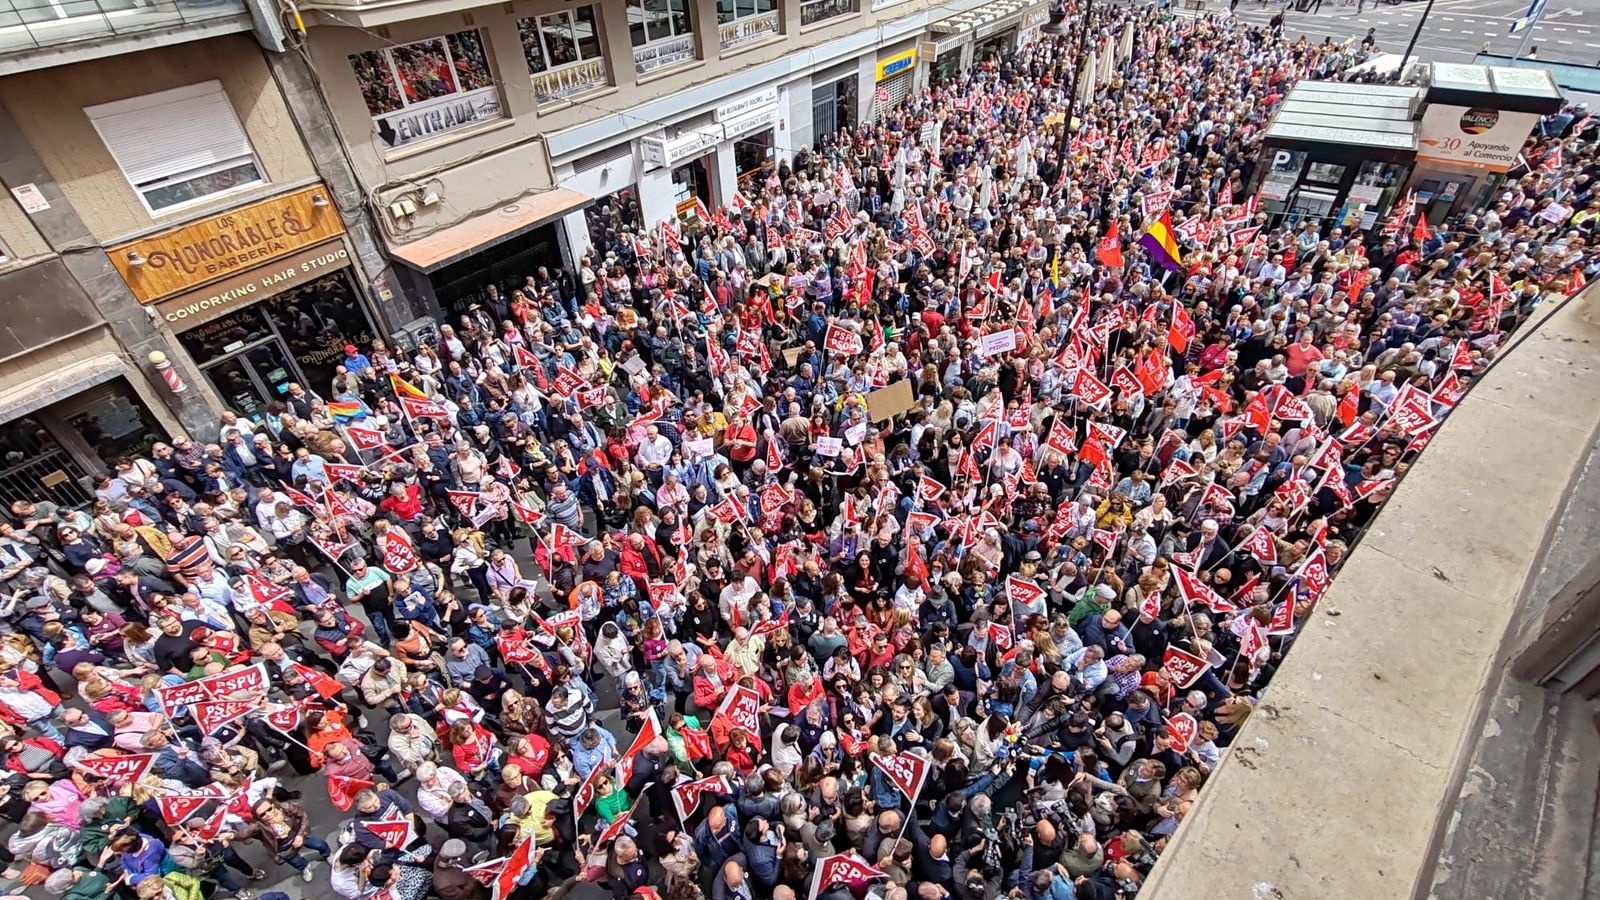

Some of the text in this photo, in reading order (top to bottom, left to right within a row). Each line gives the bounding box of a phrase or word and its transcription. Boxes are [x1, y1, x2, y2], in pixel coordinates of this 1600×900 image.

[532, 61, 601, 97] GIMNASIO
[400, 100, 478, 141] ENTRADA
[1439, 137, 1461, 151] 30
[1468, 140, 1509, 152] Apoyando
[1270, 150, 1291, 170] P
[1473, 151, 1513, 162] Comercio
[217, 216, 234, 231] LOS
[148, 206, 316, 274] HONORABLES
[204, 241, 286, 274] BARBERÍA
[166, 249, 347, 323] COWORKING HAIR STUDIO
[387, 539, 413, 559] PSPV
[386, 552, 410, 570] SOE
[1168, 655, 1199, 673] PSPV
